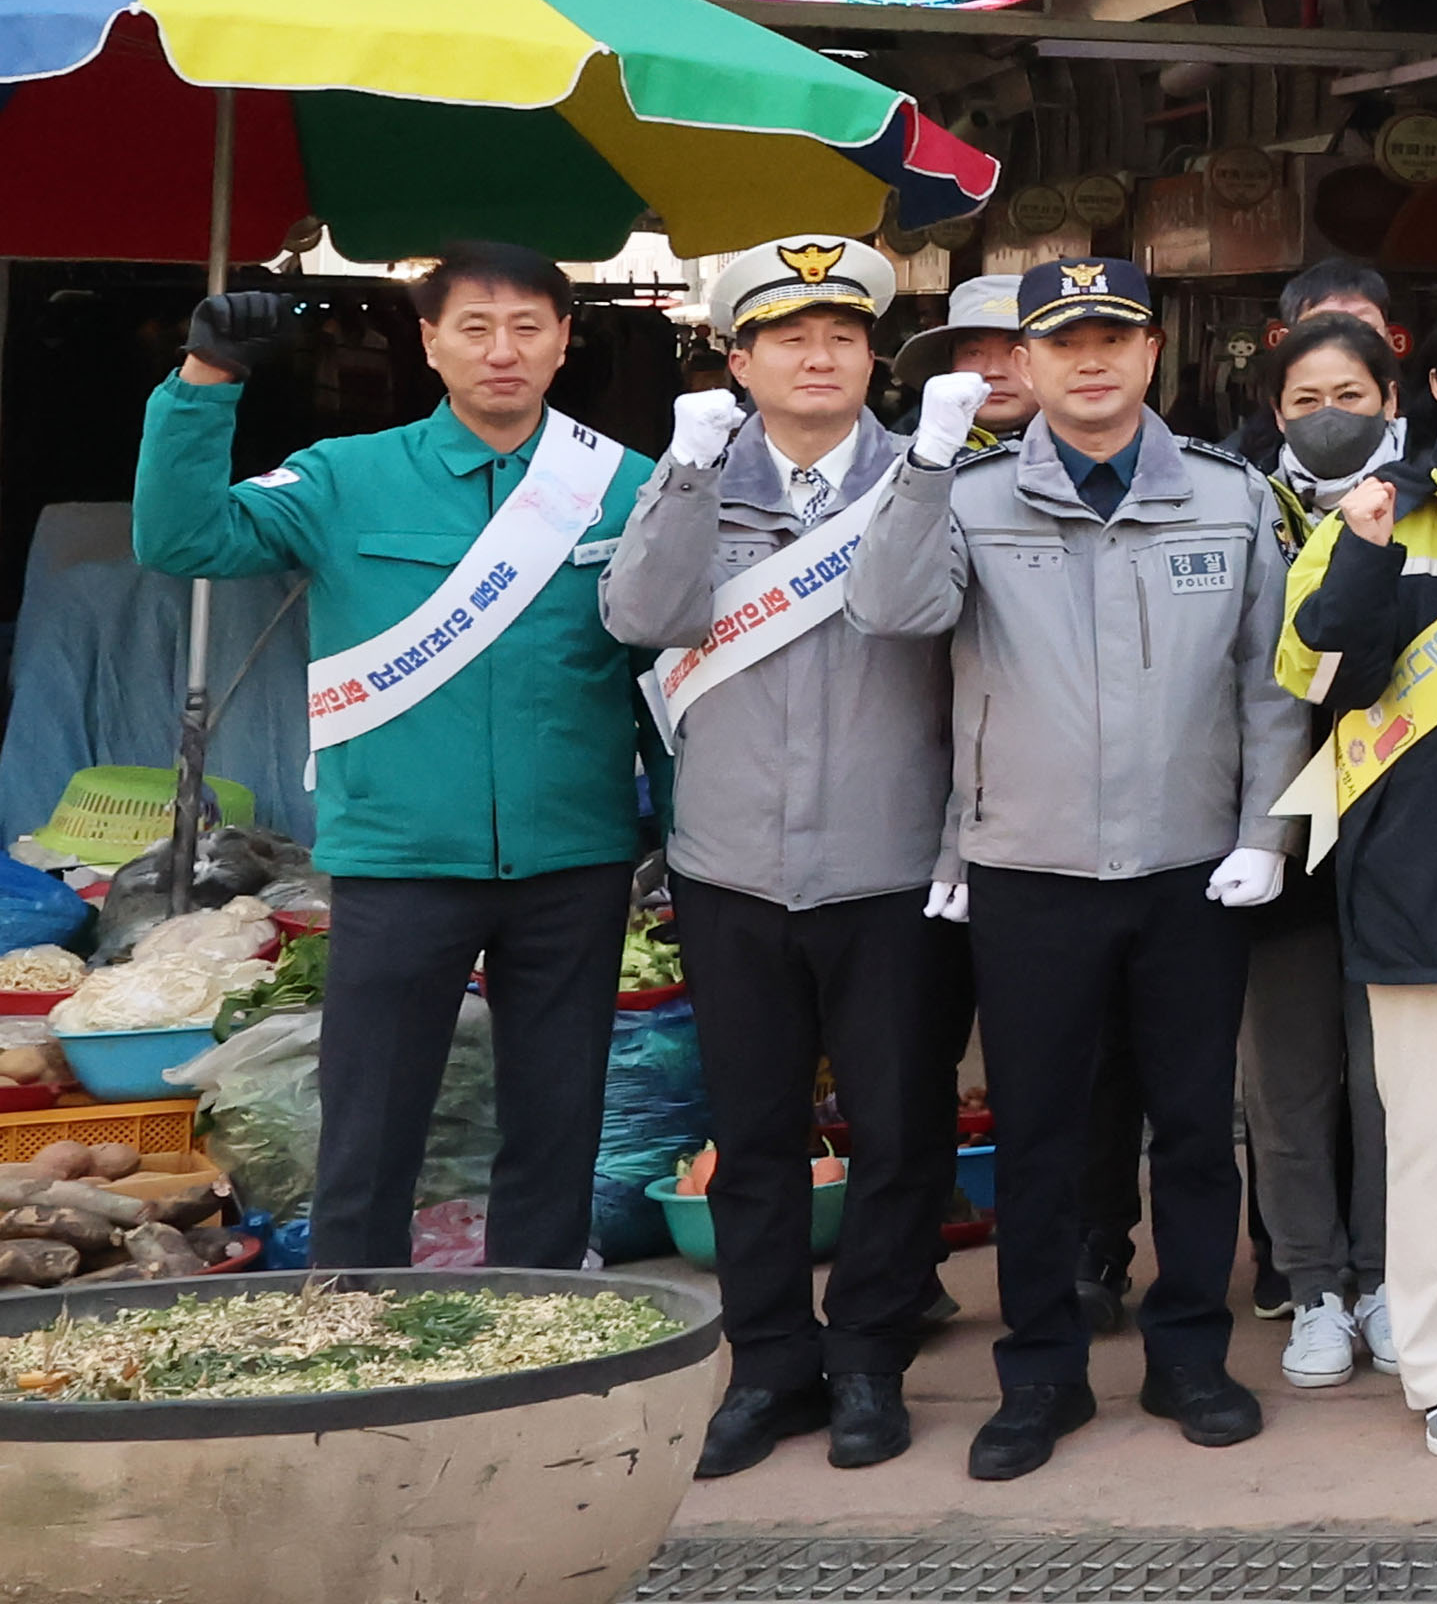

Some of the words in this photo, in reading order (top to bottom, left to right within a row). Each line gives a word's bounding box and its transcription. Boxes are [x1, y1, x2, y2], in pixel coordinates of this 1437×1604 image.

[469, 560, 519, 612] 생활
[790, 533, 862, 602] 전점검
[1173, 552, 1223, 575] 경찰
[1176, 575, 1226, 589] POLICE
[366, 608, 475, 693] 안전점검
